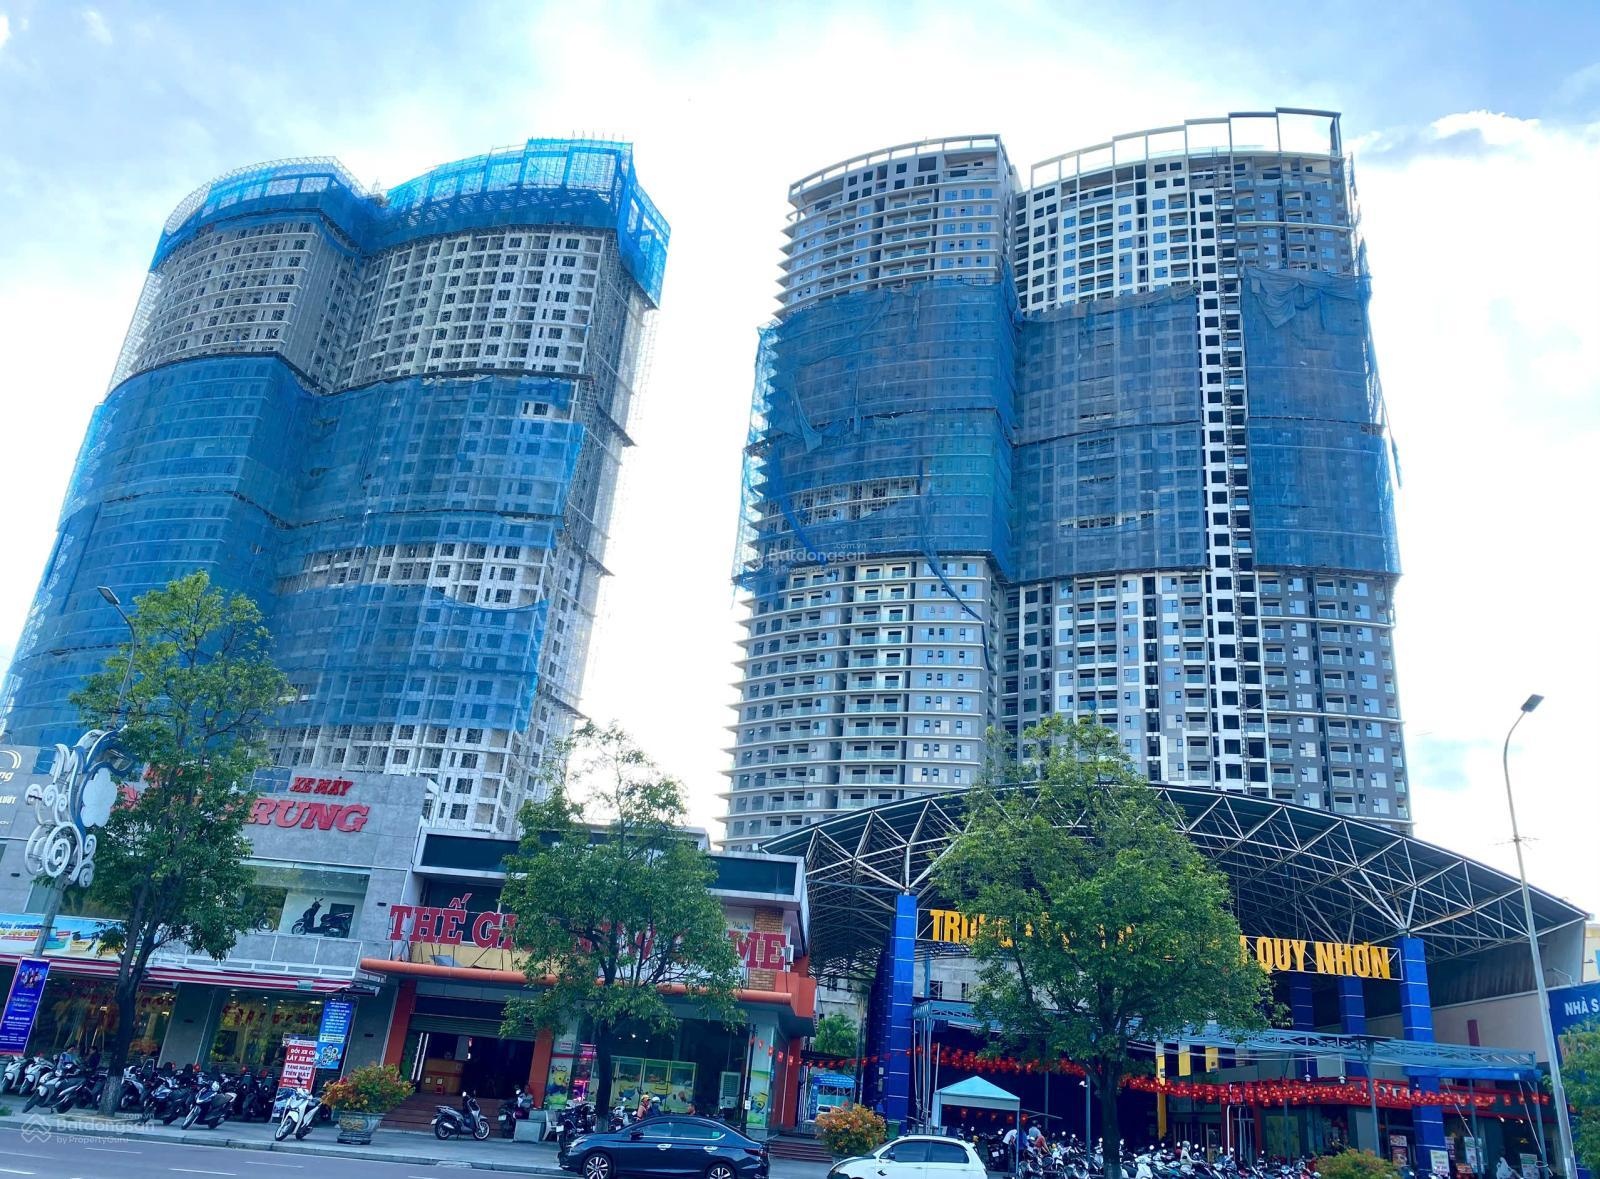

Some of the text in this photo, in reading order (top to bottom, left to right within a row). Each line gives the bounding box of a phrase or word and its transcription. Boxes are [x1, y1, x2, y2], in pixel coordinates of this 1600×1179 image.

[290, 776, 313, 794] XE
[241, 798, 371, 833] RUNG
[389, 892, 472, 946] THẾ
[472, 910, 518, 950] GI
[728, 929, 788, 971] ME
[1256, 936, 1307, 974] QUY
[1315, 941, 1392, 980] NHƠN
[1564, 996, 1600, 1017] NHÀ S
